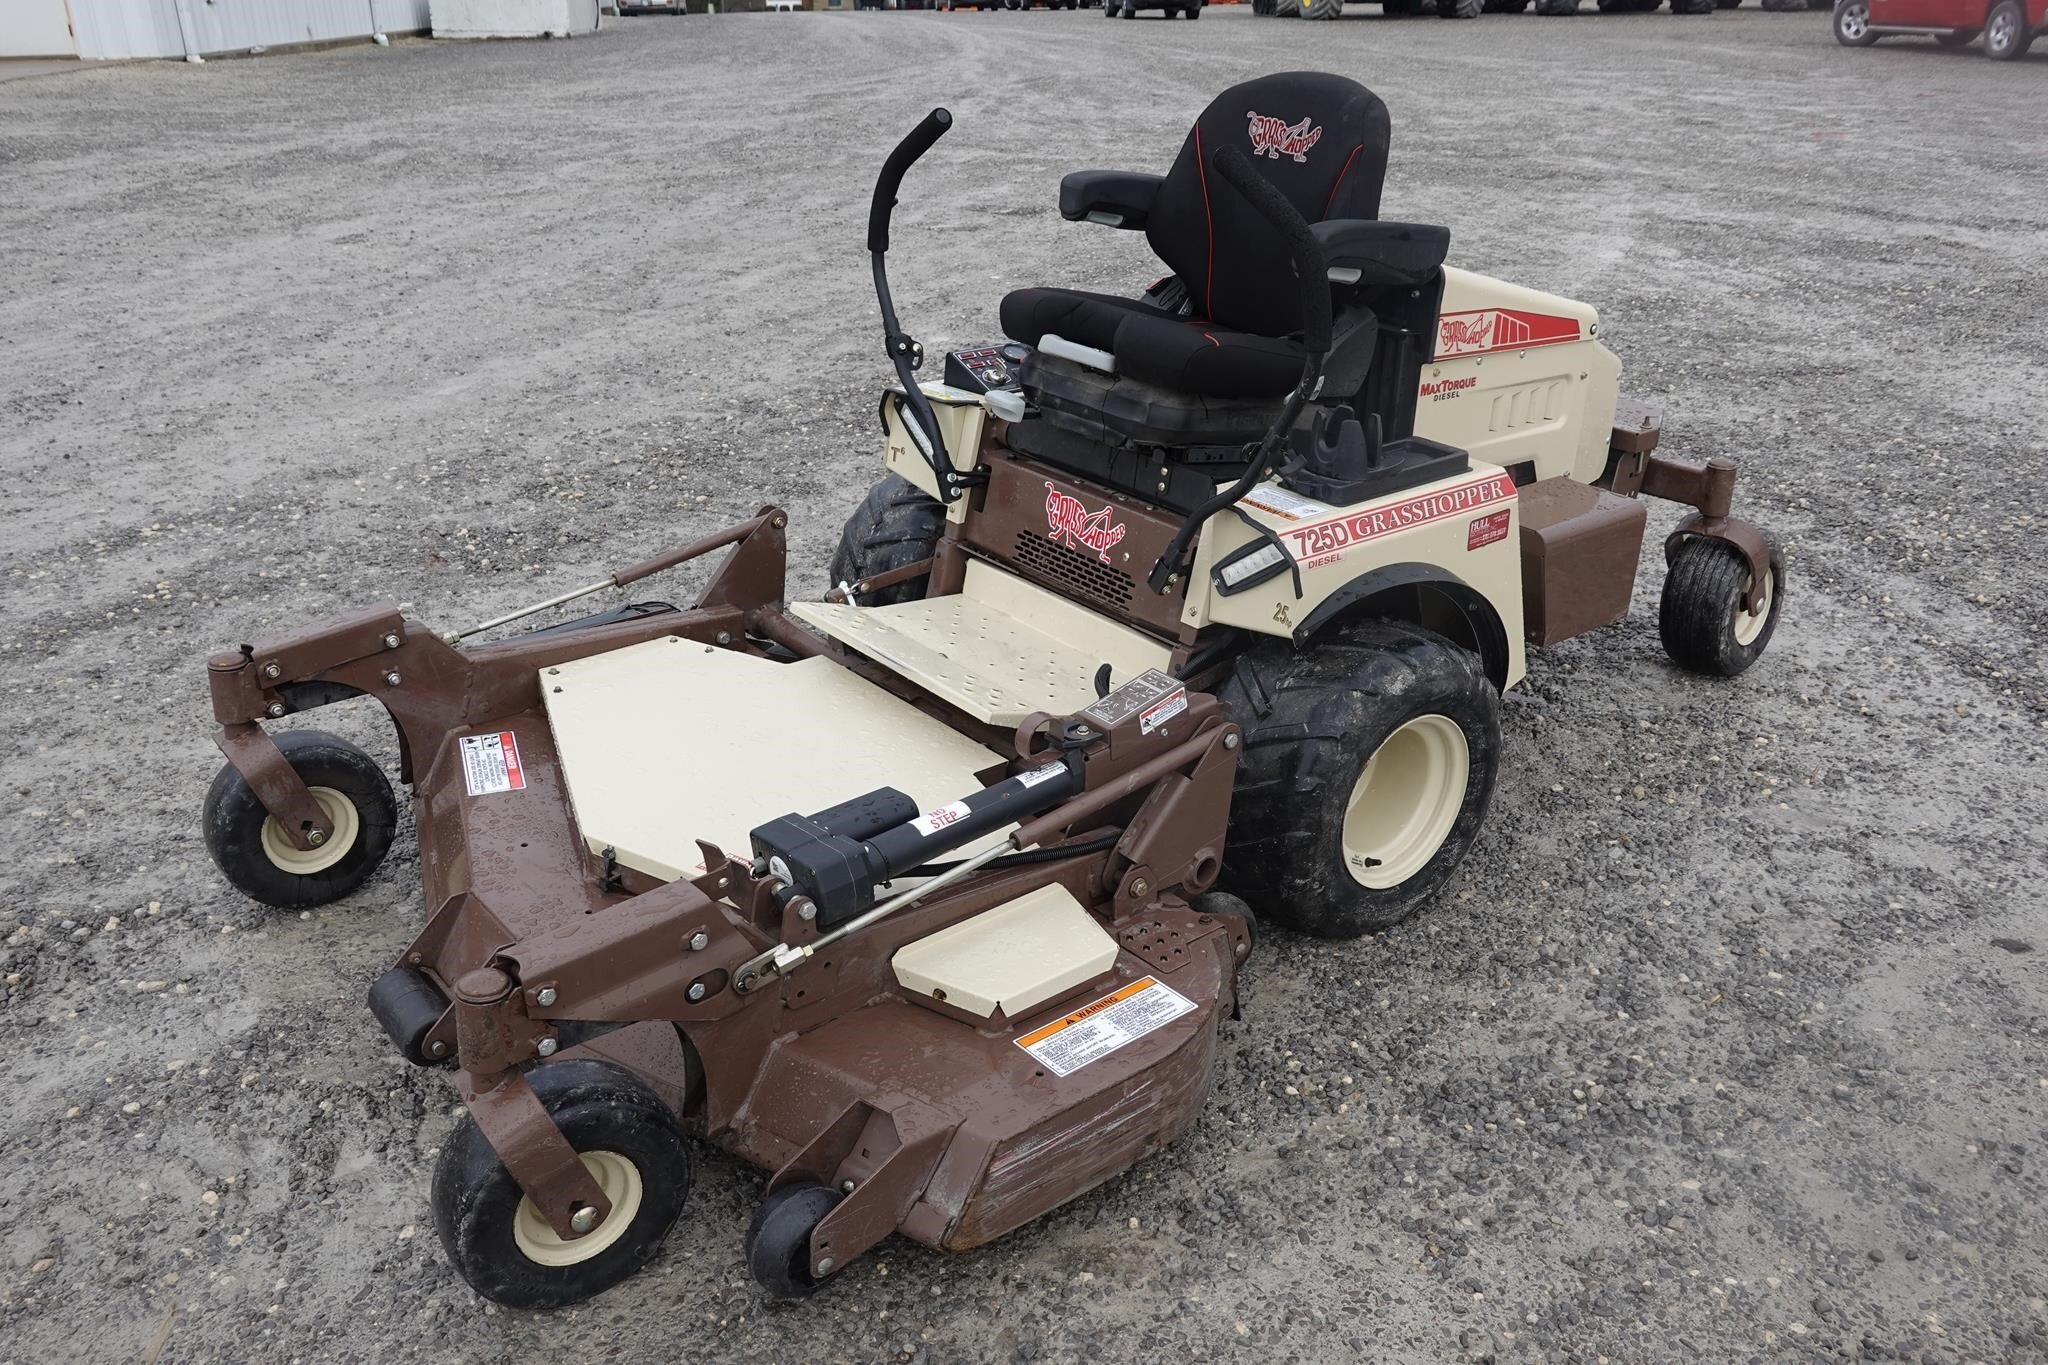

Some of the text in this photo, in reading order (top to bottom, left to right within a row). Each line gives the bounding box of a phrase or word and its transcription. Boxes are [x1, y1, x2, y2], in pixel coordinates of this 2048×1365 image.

[1433, 391, 1461, 402] DIESEL
[1293, 522, 1349, 556] 725D
[1355, 480, 1504, 536] GRASSHOPPER
[1471, 518, 1490, 532] HULL
[1308, 554, 1342, 569] DIESEL
[927, 808, 947, 818] NO
[930, 811, 959, 829] STEP
[1077, 997, 1119, 1018] WARNING
